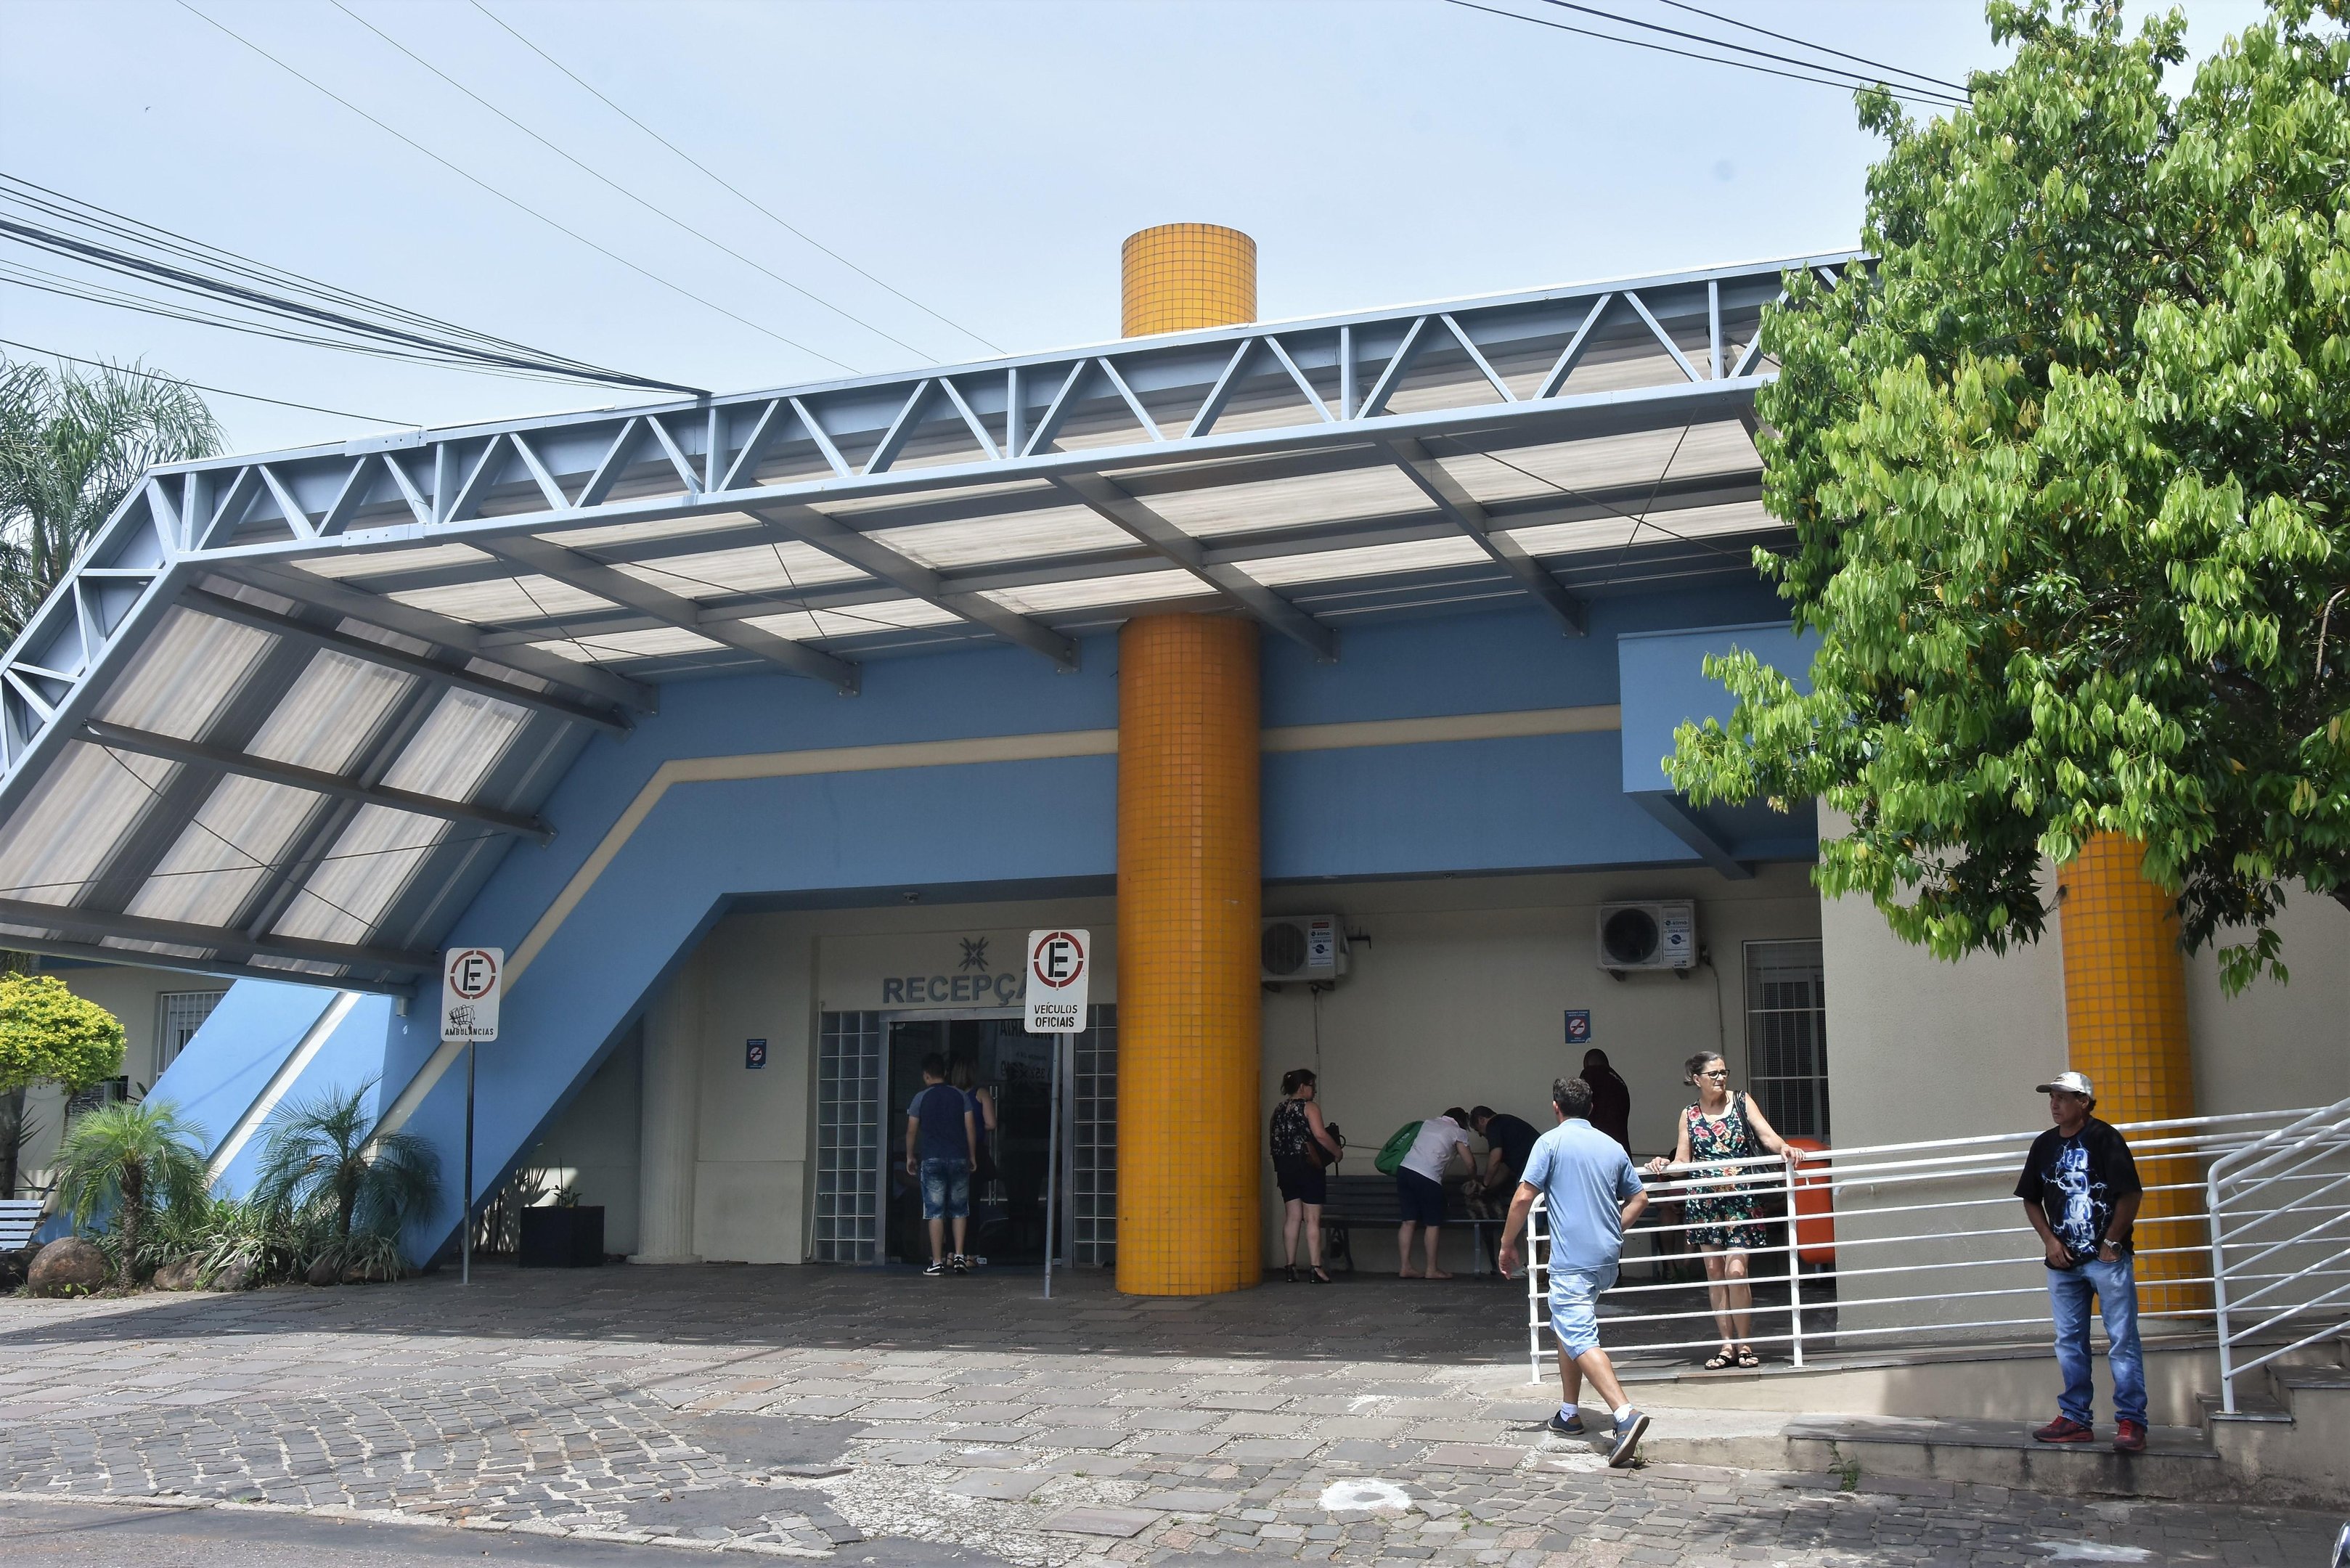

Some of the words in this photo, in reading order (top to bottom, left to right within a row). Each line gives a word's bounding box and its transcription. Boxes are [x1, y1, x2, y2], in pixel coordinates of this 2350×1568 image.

[462, 959, 484, 991] E
[1048, 942, 1069, 977] E
[883, 973, 1027, 1006] RECEPÇ
[1034, 1002, 1078, 1014] VEÍCULOS
[1035, 1017, 1074, 1028] OFICIAIS
